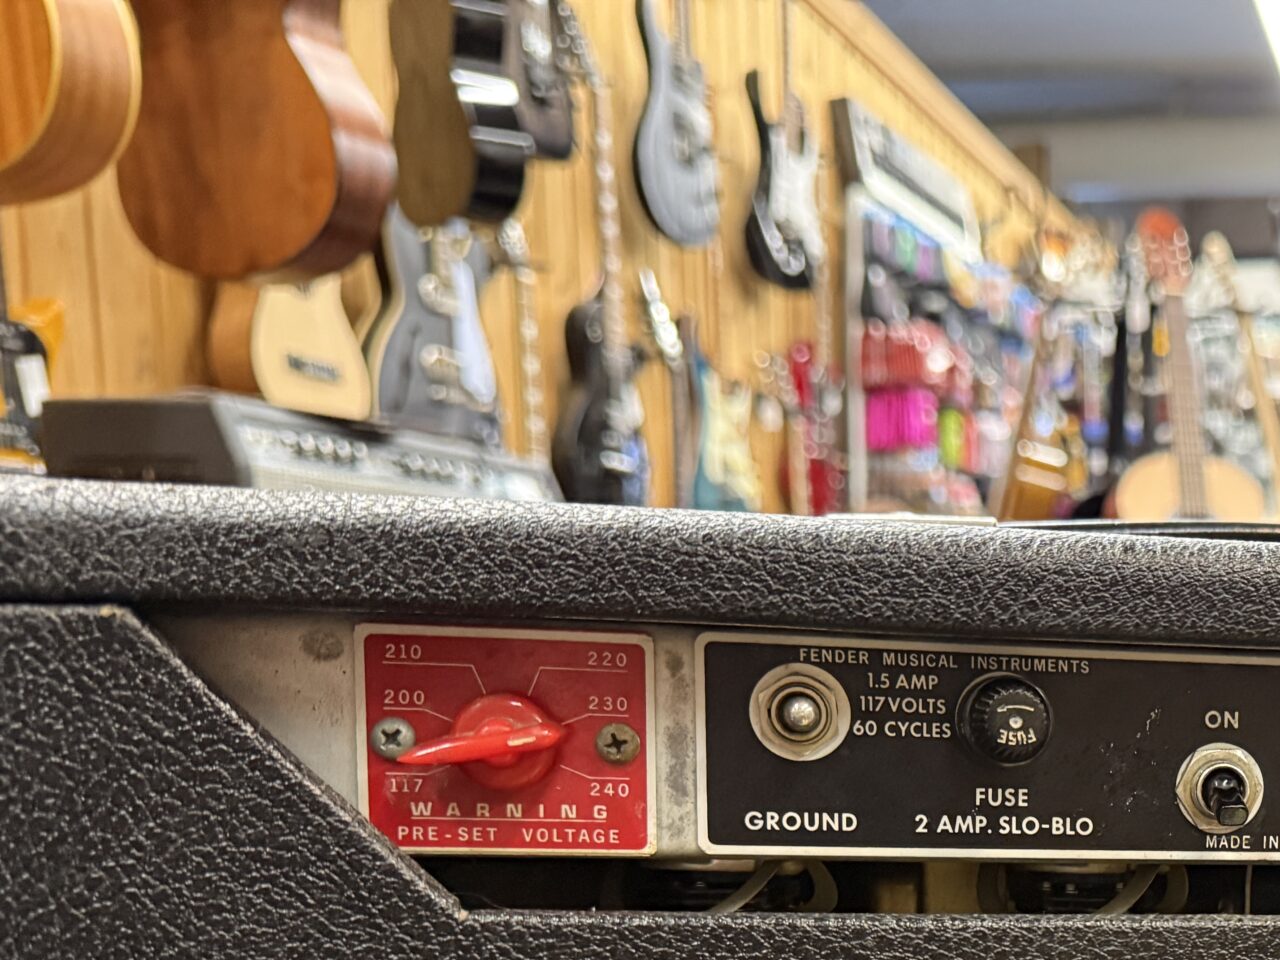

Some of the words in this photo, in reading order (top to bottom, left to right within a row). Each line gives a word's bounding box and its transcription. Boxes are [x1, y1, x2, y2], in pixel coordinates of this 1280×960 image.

[385, 644, 421, 659] 210
[588, 652, 627, 667] 220
[800, 648, 869, 664] FENDER
[883, 652, 958, 668] MUSICAL
[971, 655, 1090, 674] INSTRUMENTS
[867, 672, 890, 688] 1.5
[895, 674, 939, 690] AMP
[384, 690, 424, 704] 200
[589, 696, 628, 711] 230
[1205, 711, 1239, 728] ON
[853, 720, 877, 736] 60
[884, 721, 951, 738] CYCLES
[997, 728, 1036, 745] FUSE
[390, 779, 422, 792] 117
[590, 783, 629, 797] 240
[975, 788, 1028, 807] FUSE
[410, 802, 607, 818] WARNING
[744, 811, 858, 832] GROUND
[915, 815, 928, 834] 2
[937, 815, 991, 834] AMP.
[998, 816, 1093, 836] SLO-BLO
[398, 826, 497, 841] PRE-SET
[522, 828, 620, 843] VOLTAGE
[1206, 835, 1250, 849] MADE
[1263, 836, 1279, 849] IN
